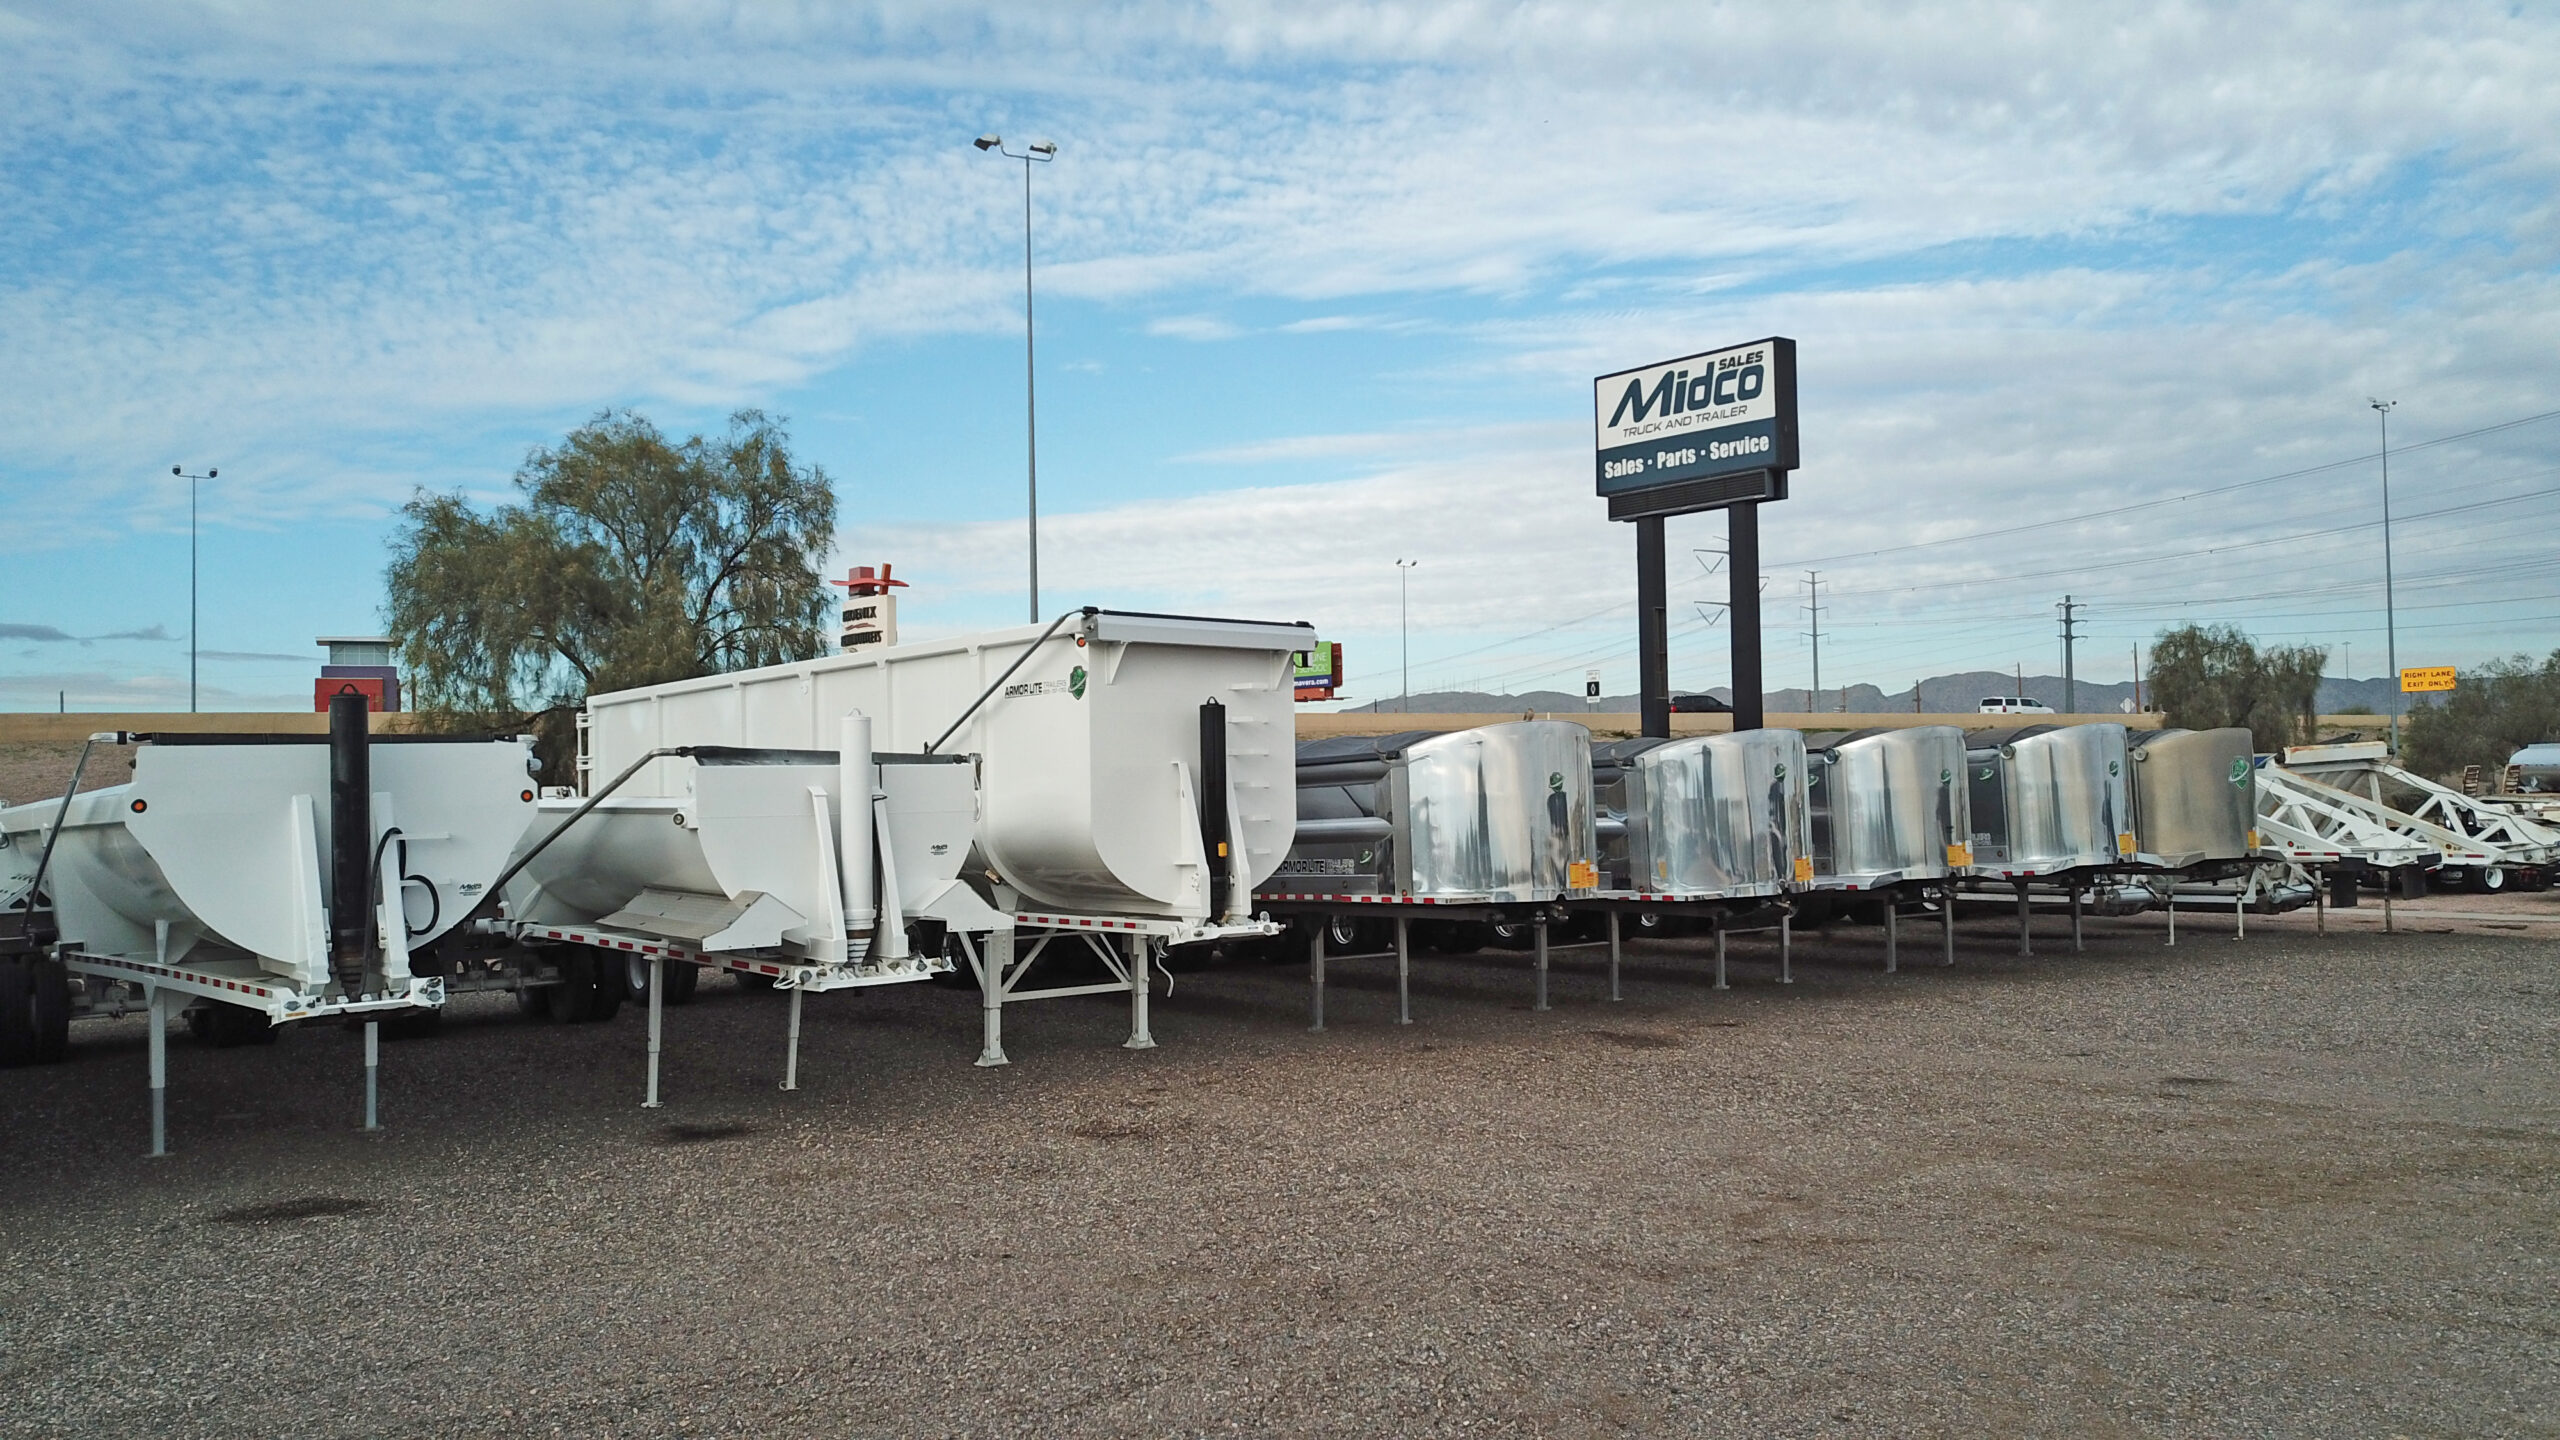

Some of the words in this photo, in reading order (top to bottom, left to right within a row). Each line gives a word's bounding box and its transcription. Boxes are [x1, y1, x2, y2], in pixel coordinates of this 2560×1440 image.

[1718, 350, 1764, 371] SALES
[1607, 361, 1765, 428] Midco
[1622, 421, 1662, 438] TRUCK
[1665, 415, 1692, 430] AND
[1696, 405, 1748, 424] TRAILER
[1604, 458, 1644, 479] Sales
[1657, 448, 1696, 469] Parts
[1709, 435, 1770, 460] Service
[1005, 683, 1028, 697] ARMOR
[1029, 682, 1043, 694] LITE
[1308, 860, 1325, 873] LITE
